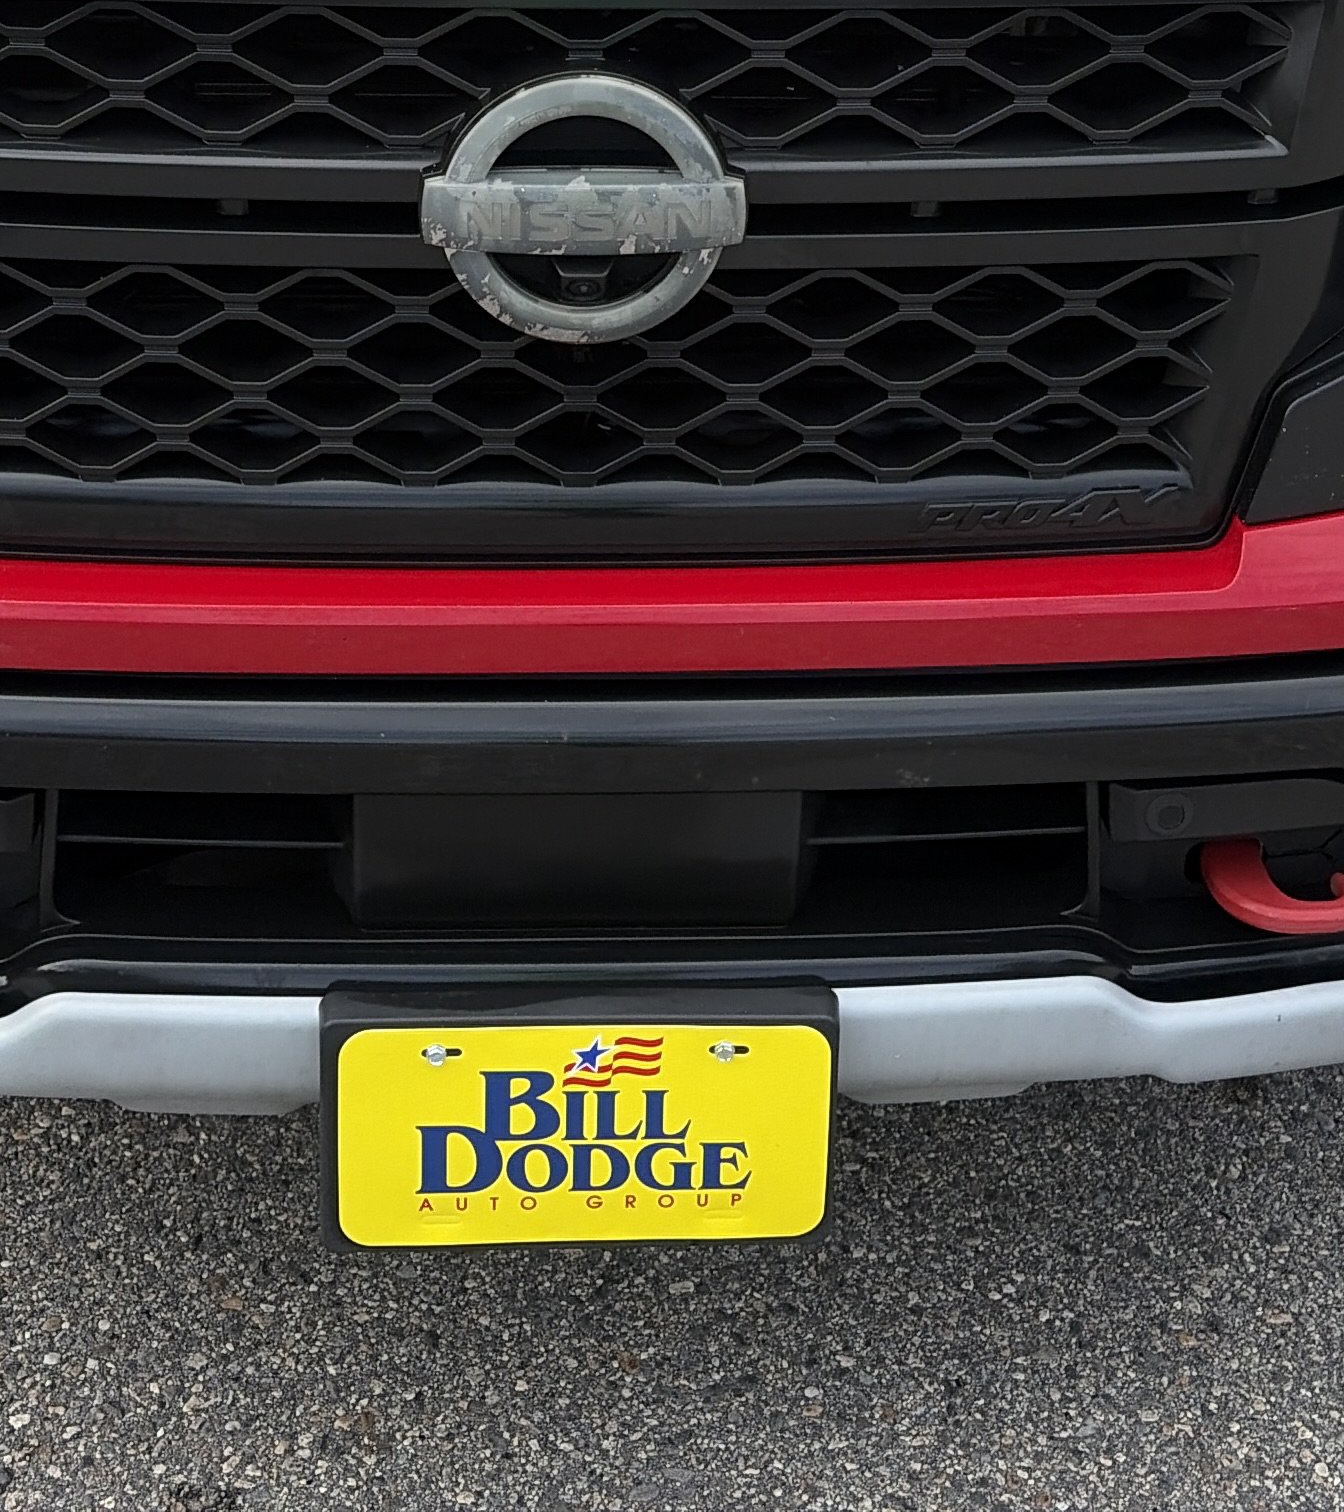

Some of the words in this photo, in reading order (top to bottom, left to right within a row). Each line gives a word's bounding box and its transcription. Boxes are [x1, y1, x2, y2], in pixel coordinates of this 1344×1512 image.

[464, 199, 712, 241] NISSAN
[479, 1070, 691, 1141] BILL
[416, 1125, 752, 1193] DODGE
[419, 1197, 537, 1212] AUTO
[586, 1194, 742, 1210] GROUP
